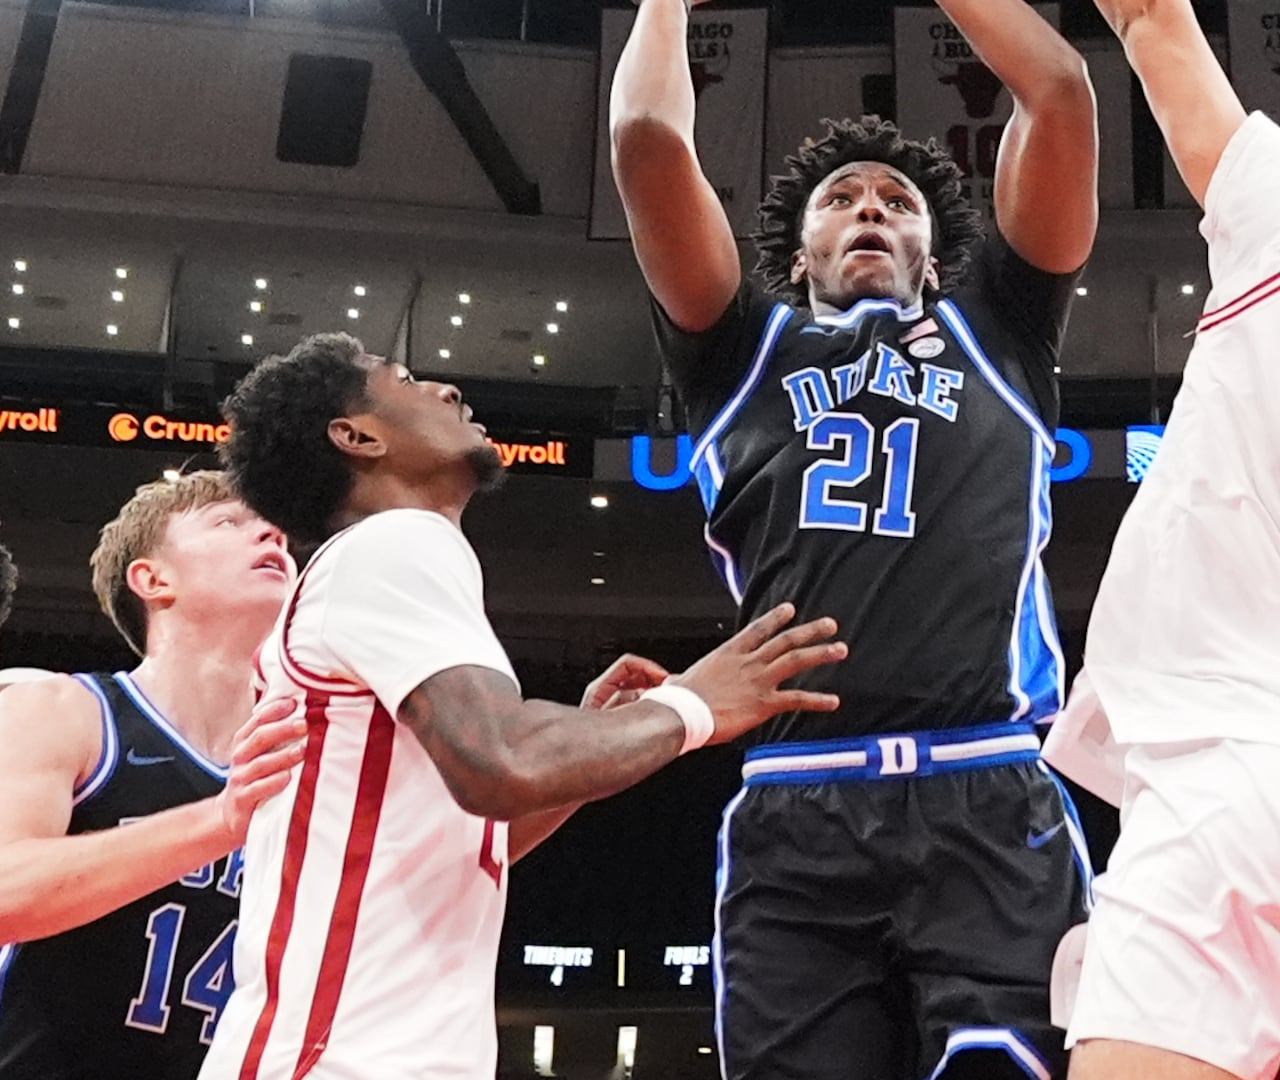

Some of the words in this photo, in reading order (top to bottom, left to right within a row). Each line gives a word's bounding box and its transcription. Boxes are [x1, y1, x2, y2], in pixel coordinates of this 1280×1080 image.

[781, 343, 964, 431] DUKE
[798, 411, 919, 537] 21
[523, 945, 594, 967] TIMEOUTS
[664, 946, 711, 965] FOULS
[125, 902, 239, 1044] 14
[550, 967, 564, 987] 4
[679, 966, 694, 985] 2
